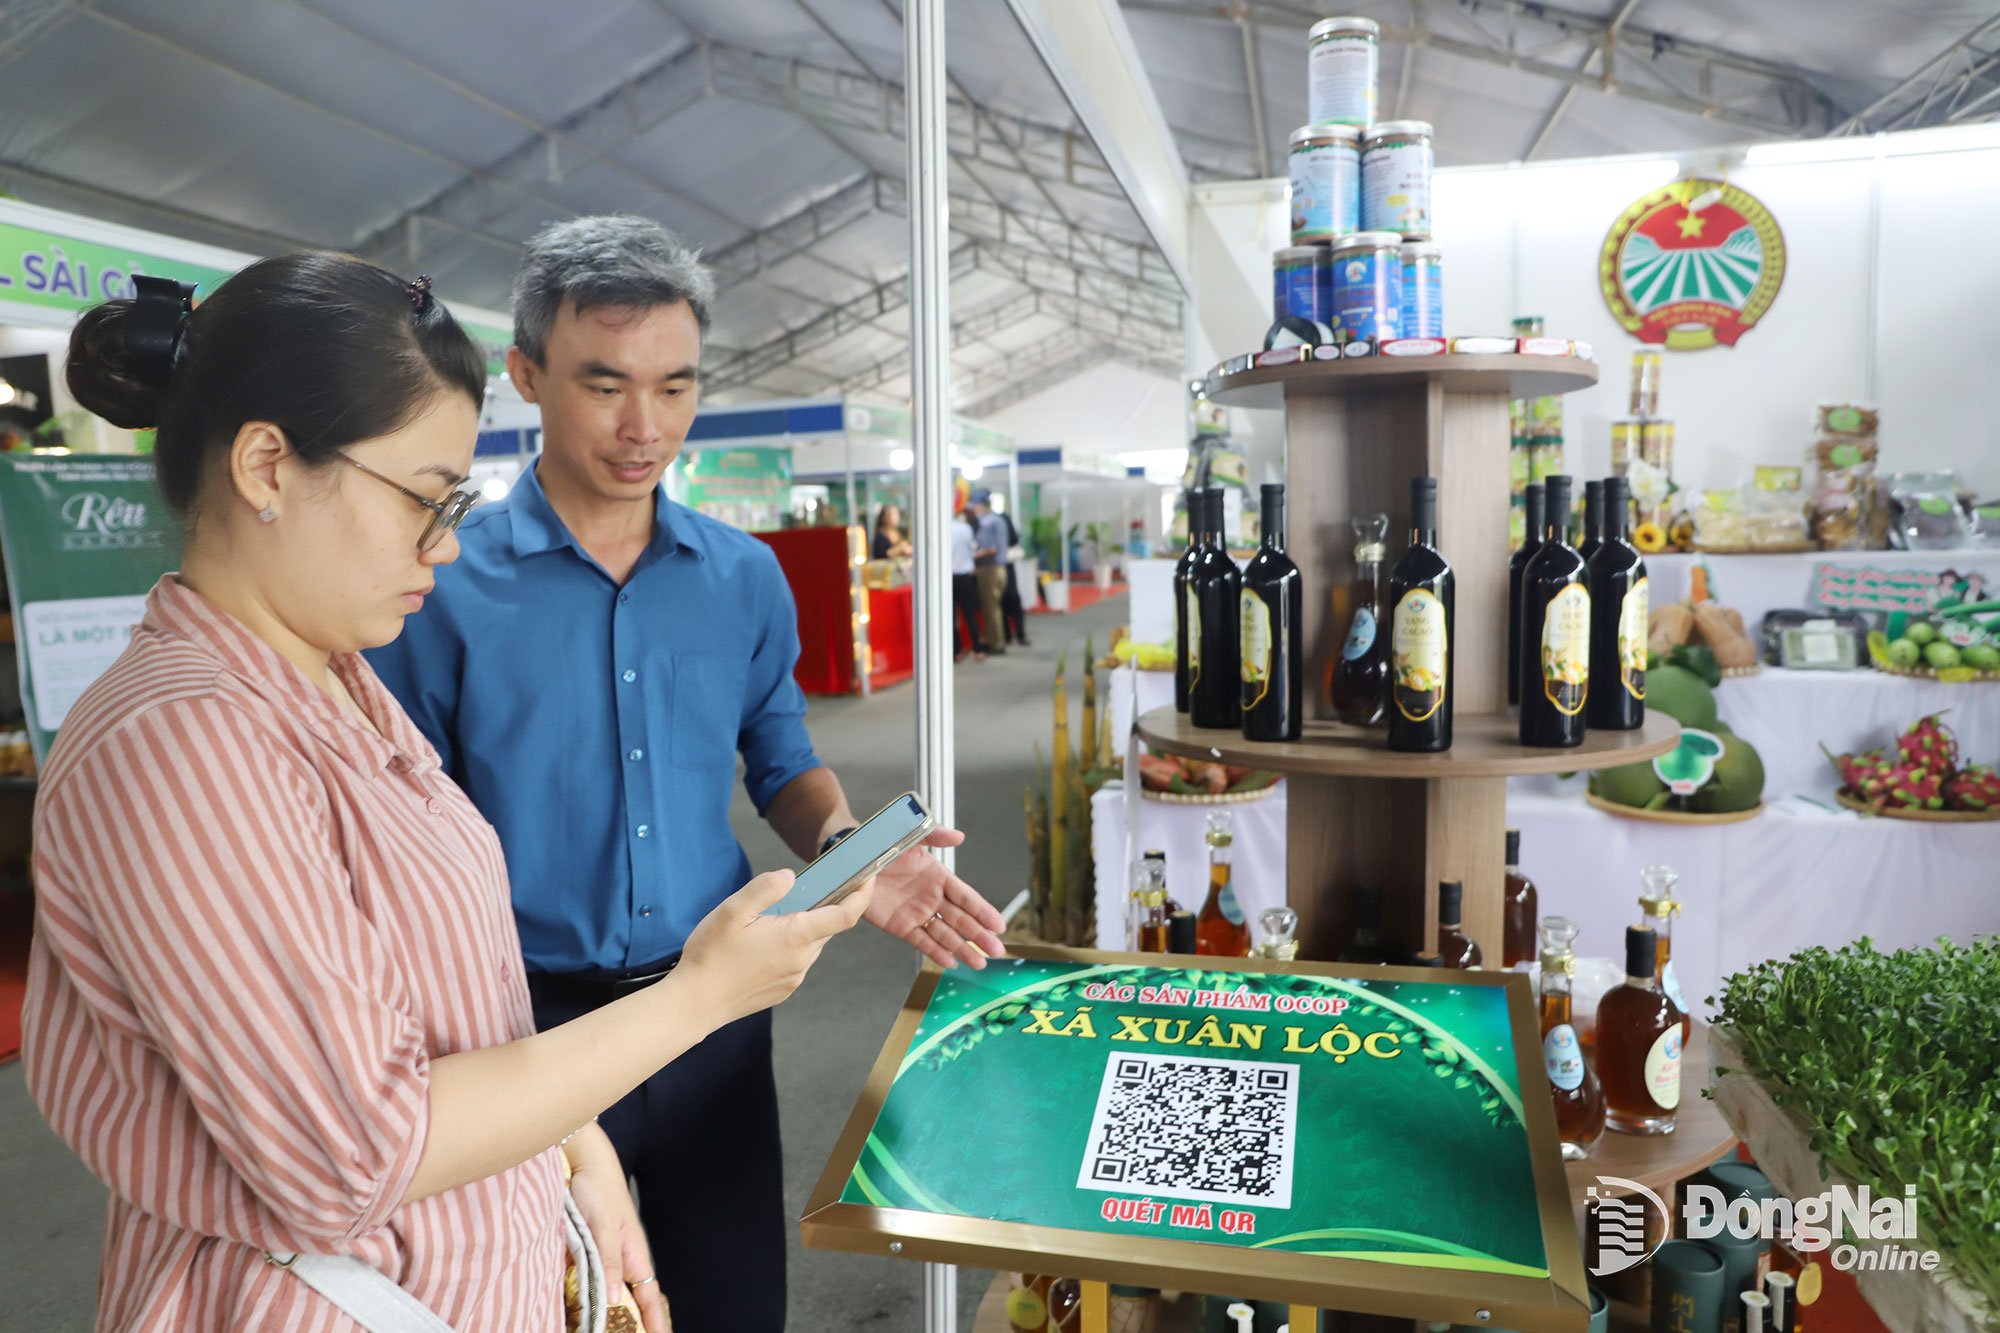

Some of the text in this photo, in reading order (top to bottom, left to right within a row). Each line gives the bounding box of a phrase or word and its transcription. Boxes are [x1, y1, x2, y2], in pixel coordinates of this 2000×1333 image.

[23, 248, 89, 298] SÀI
[1084, 979, 1349, 1017] CÁC SẢN PHẨM OCOP
[1021, 1006, 1402, 1064] XÃ XUÂN LỘC
[1101, 1197, 1256, 1235] QUÉT MÃ QR
